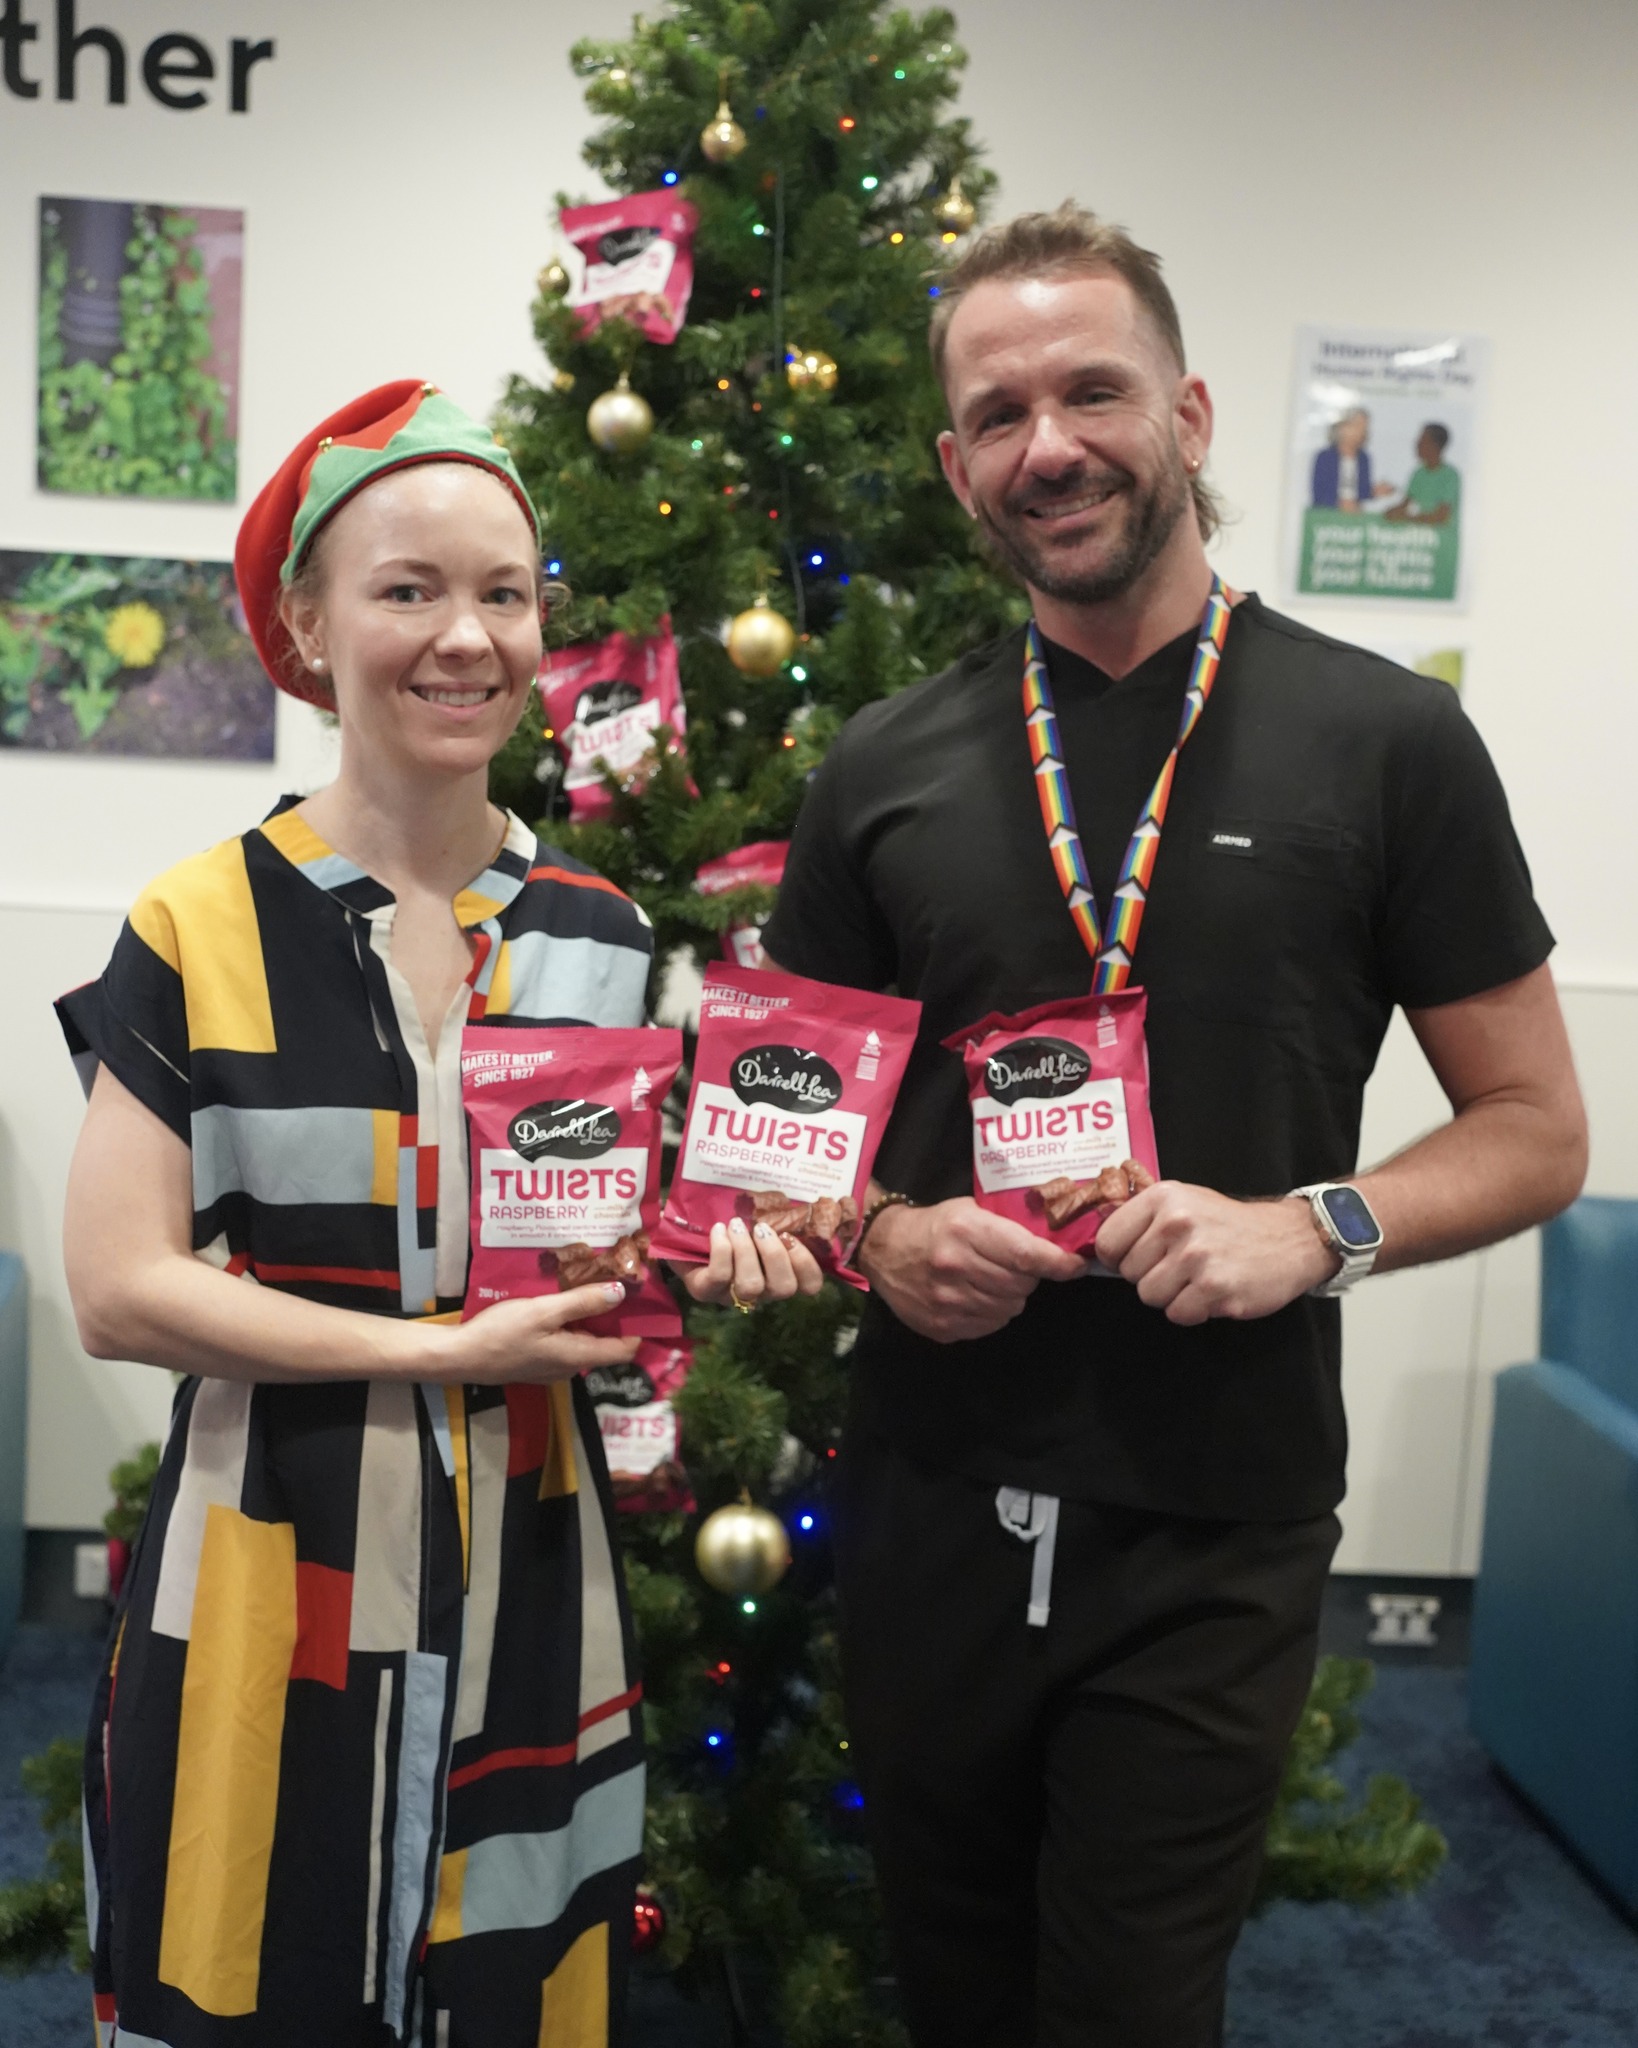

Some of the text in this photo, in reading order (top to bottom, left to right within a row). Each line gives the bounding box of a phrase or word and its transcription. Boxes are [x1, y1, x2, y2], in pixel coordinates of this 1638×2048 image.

[0, 0, 273, 112] ther
[702, 986, 789, 1008] MAKES IT BETTER
[707, 1005, 769, 1020] SINCE 1927
[461, 1050, 554, 1073] MAKES IT BETTER
[988, 1053, 1088, 1090] Darrell Lea
[474, 1067, 536, 1088] SINCE 1927
[738, 1058, 837, 1103] Darrell Lea
[580, 1115, 616, 1145] Lea
[704, 1104, 849, 1161] TWISTS
[976, 1100, 1114, 1147] TWISTS
[695, 1139, 796, 1169] RASPBERRY
[980, 1141, 1068, 1165] RASPBERRY
[491, 1168, 637, 1200] TWISTS
[490, 1205, 589, 1220] RASPBERRY
